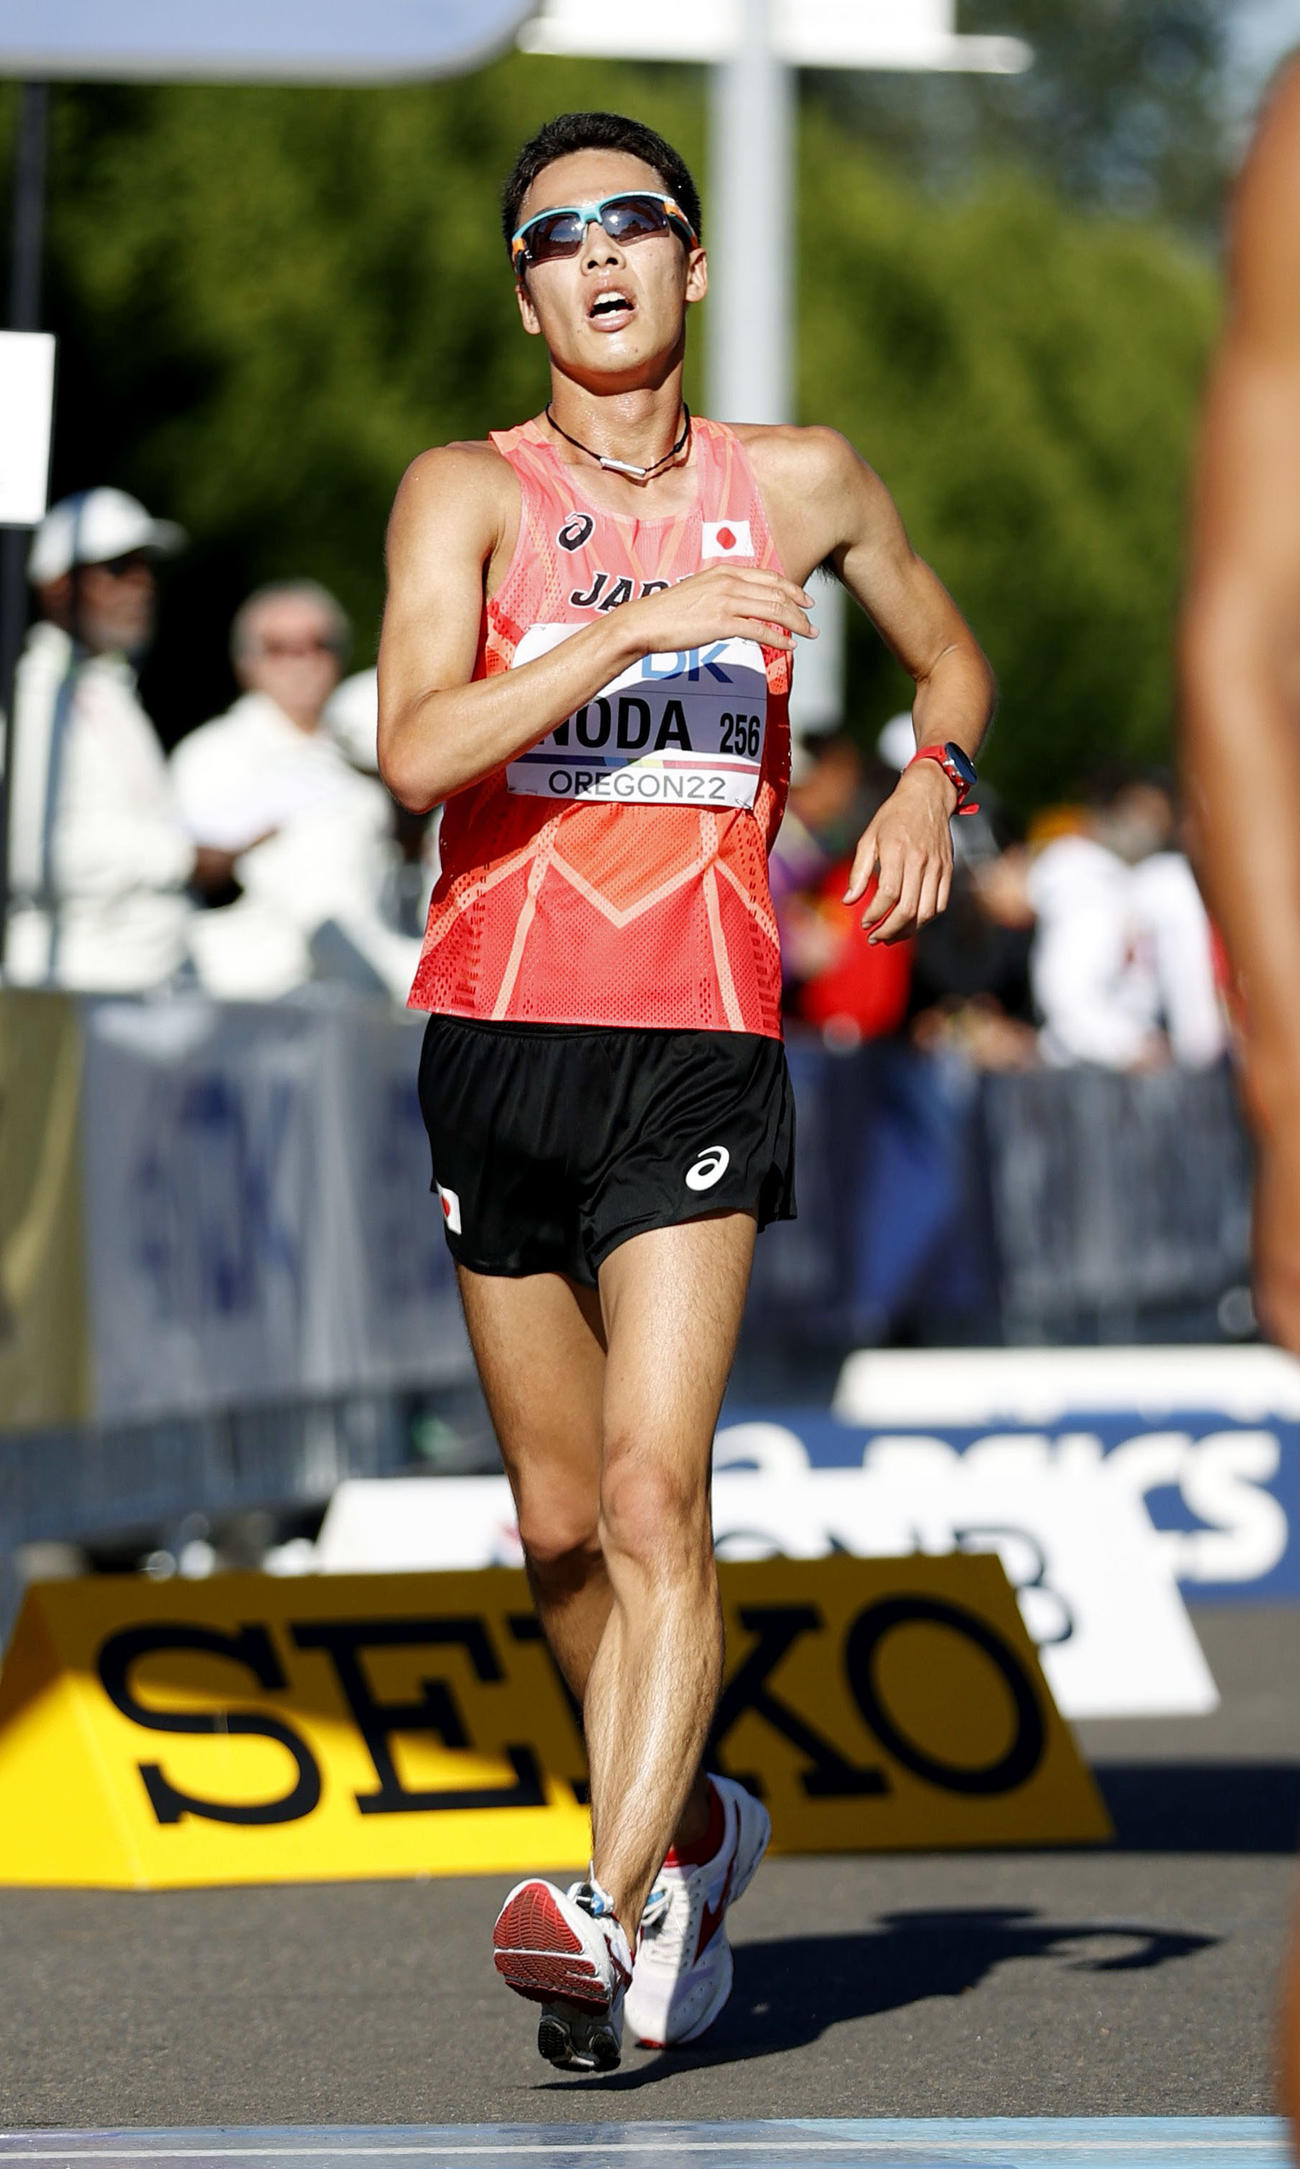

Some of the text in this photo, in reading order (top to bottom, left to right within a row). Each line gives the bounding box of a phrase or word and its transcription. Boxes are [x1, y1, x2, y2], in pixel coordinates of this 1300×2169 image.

[719, 712, 761, 757] 256
[548, 769, 726, 800] OREGON22
[97, 1592, 1045, 1825] SEKO
